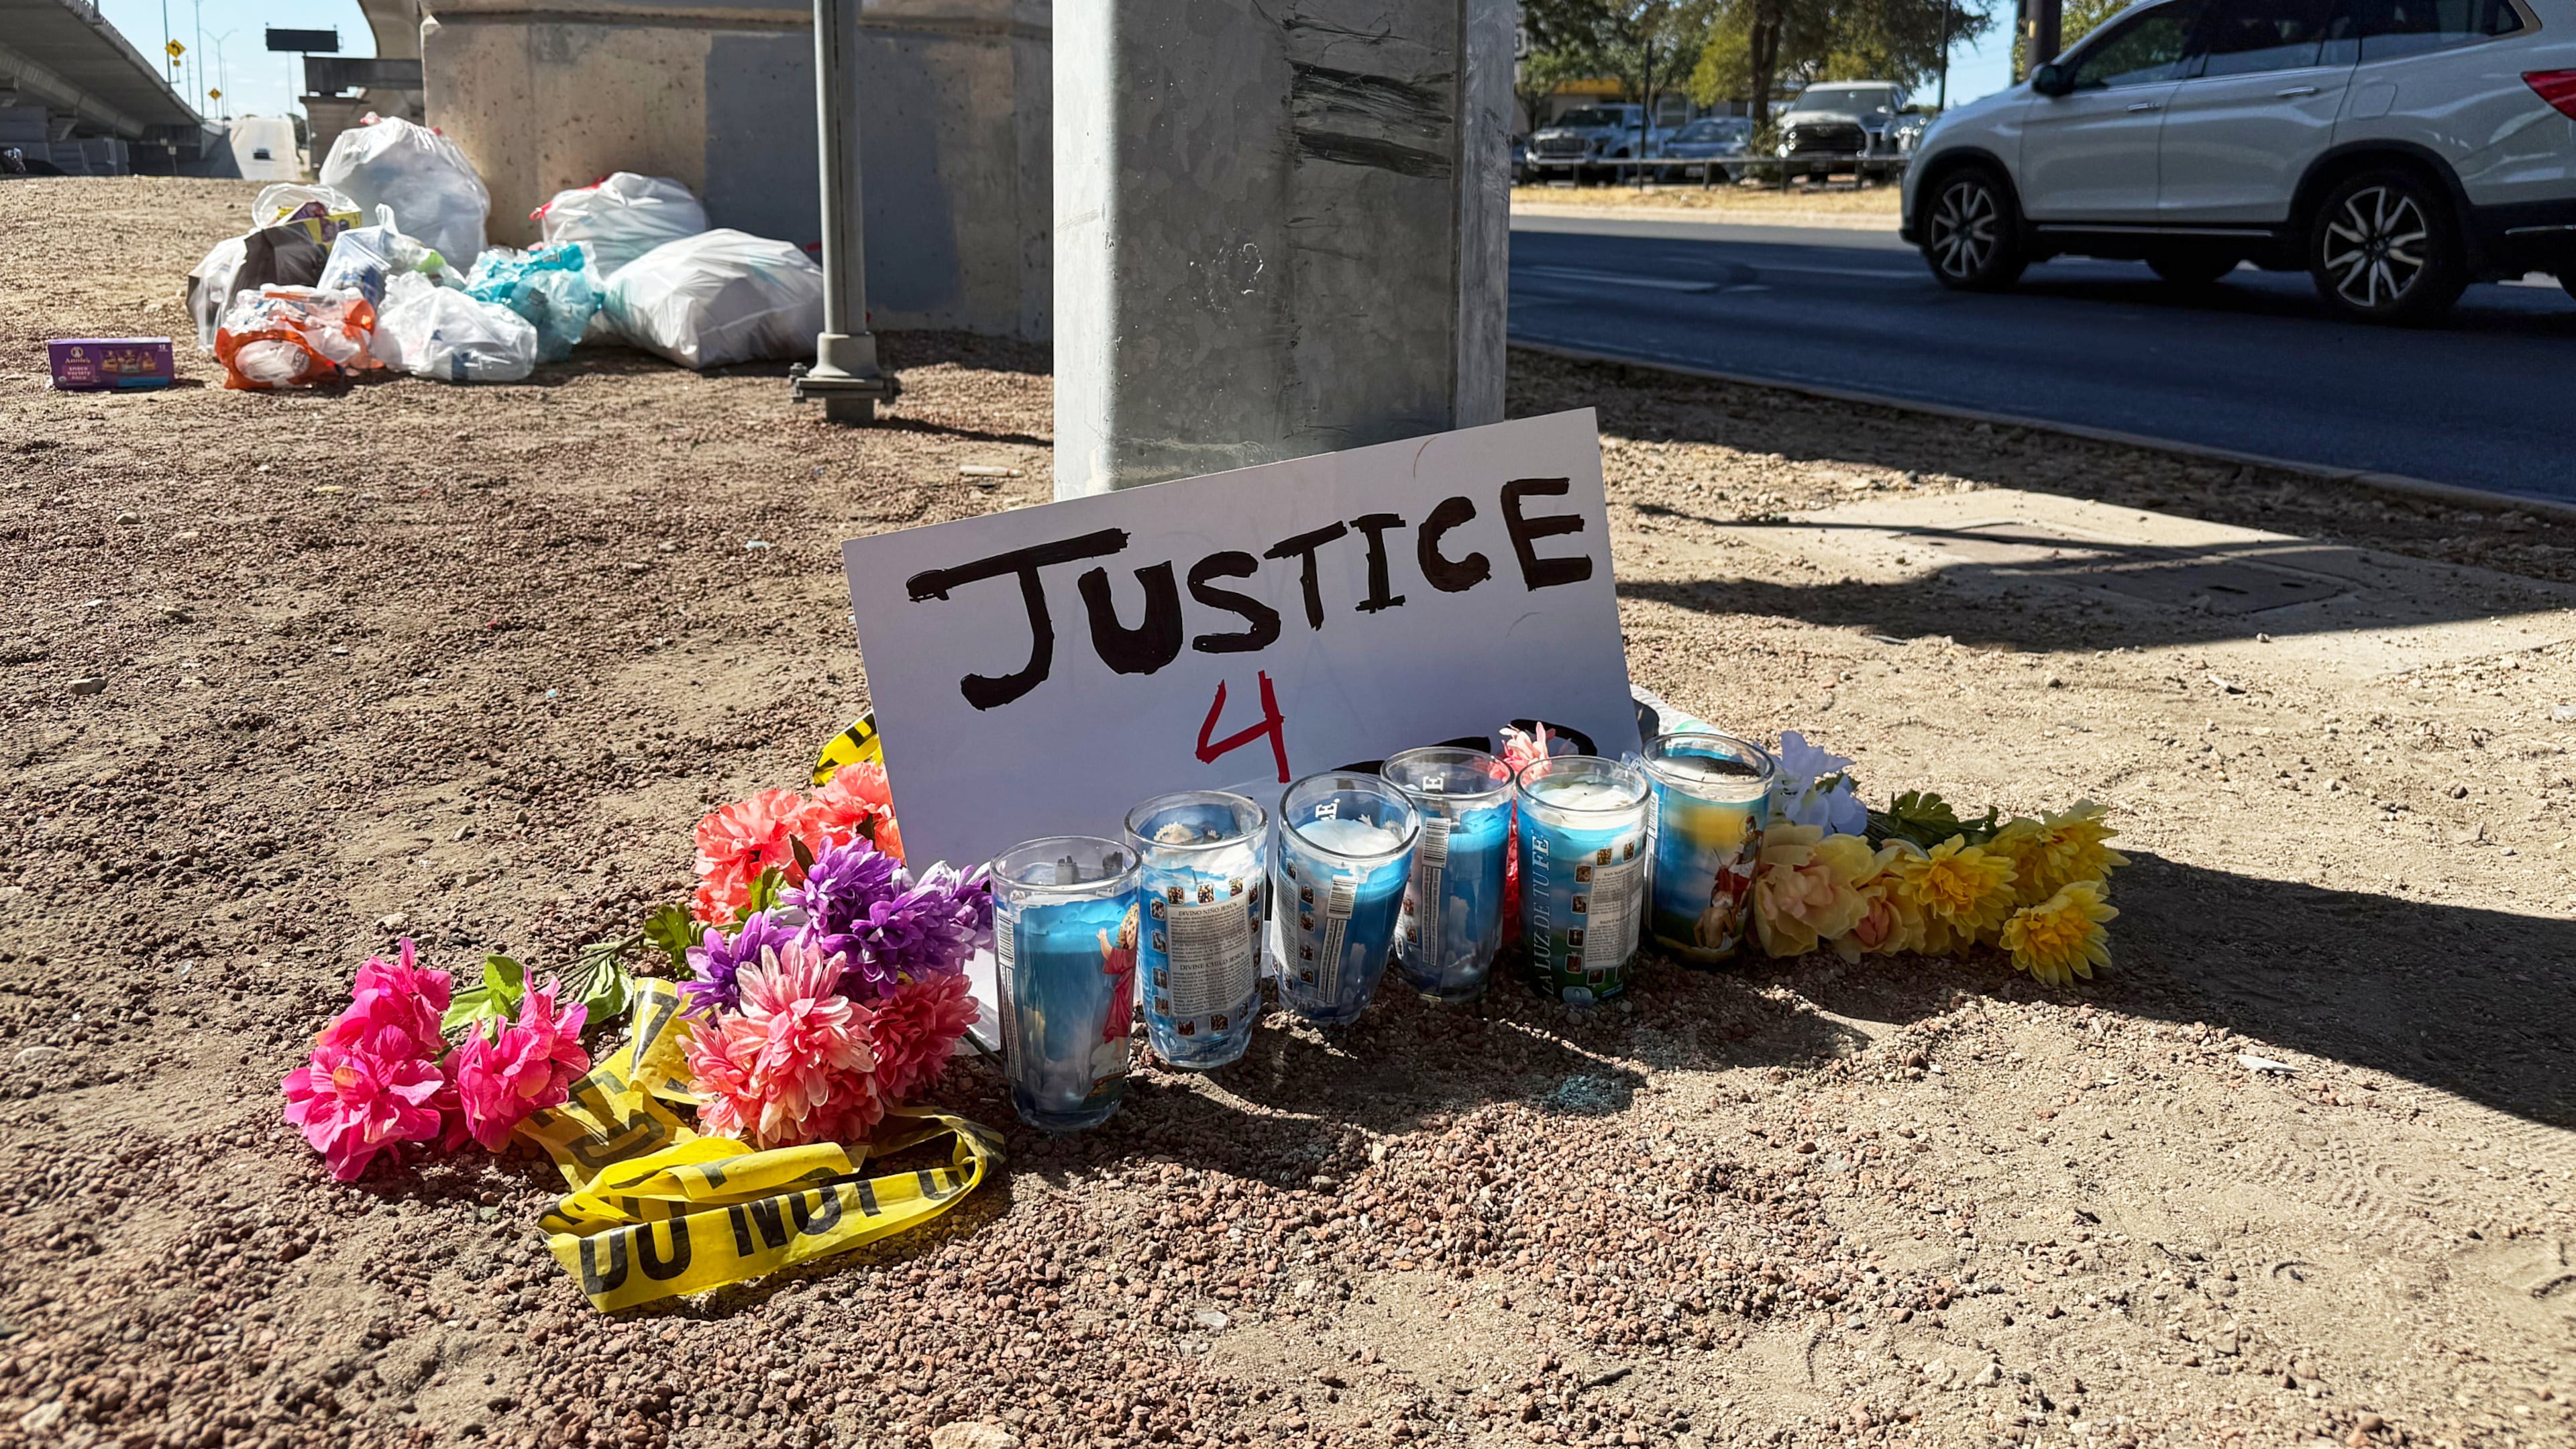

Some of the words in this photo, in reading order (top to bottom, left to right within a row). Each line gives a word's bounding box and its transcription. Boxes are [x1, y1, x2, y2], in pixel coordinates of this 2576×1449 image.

[906, 476, 1593, 711] JUSTICE
[1195, 669, 1290, 783] 4
[1533, 870, 1550, 898] TU
[1534, 902, 1550, 930] DE
[1206, 959, 1228, 968] CHILD
[1534, 932, 1551, 971] LUZ
[1539, 975, 1554, 996] LA
